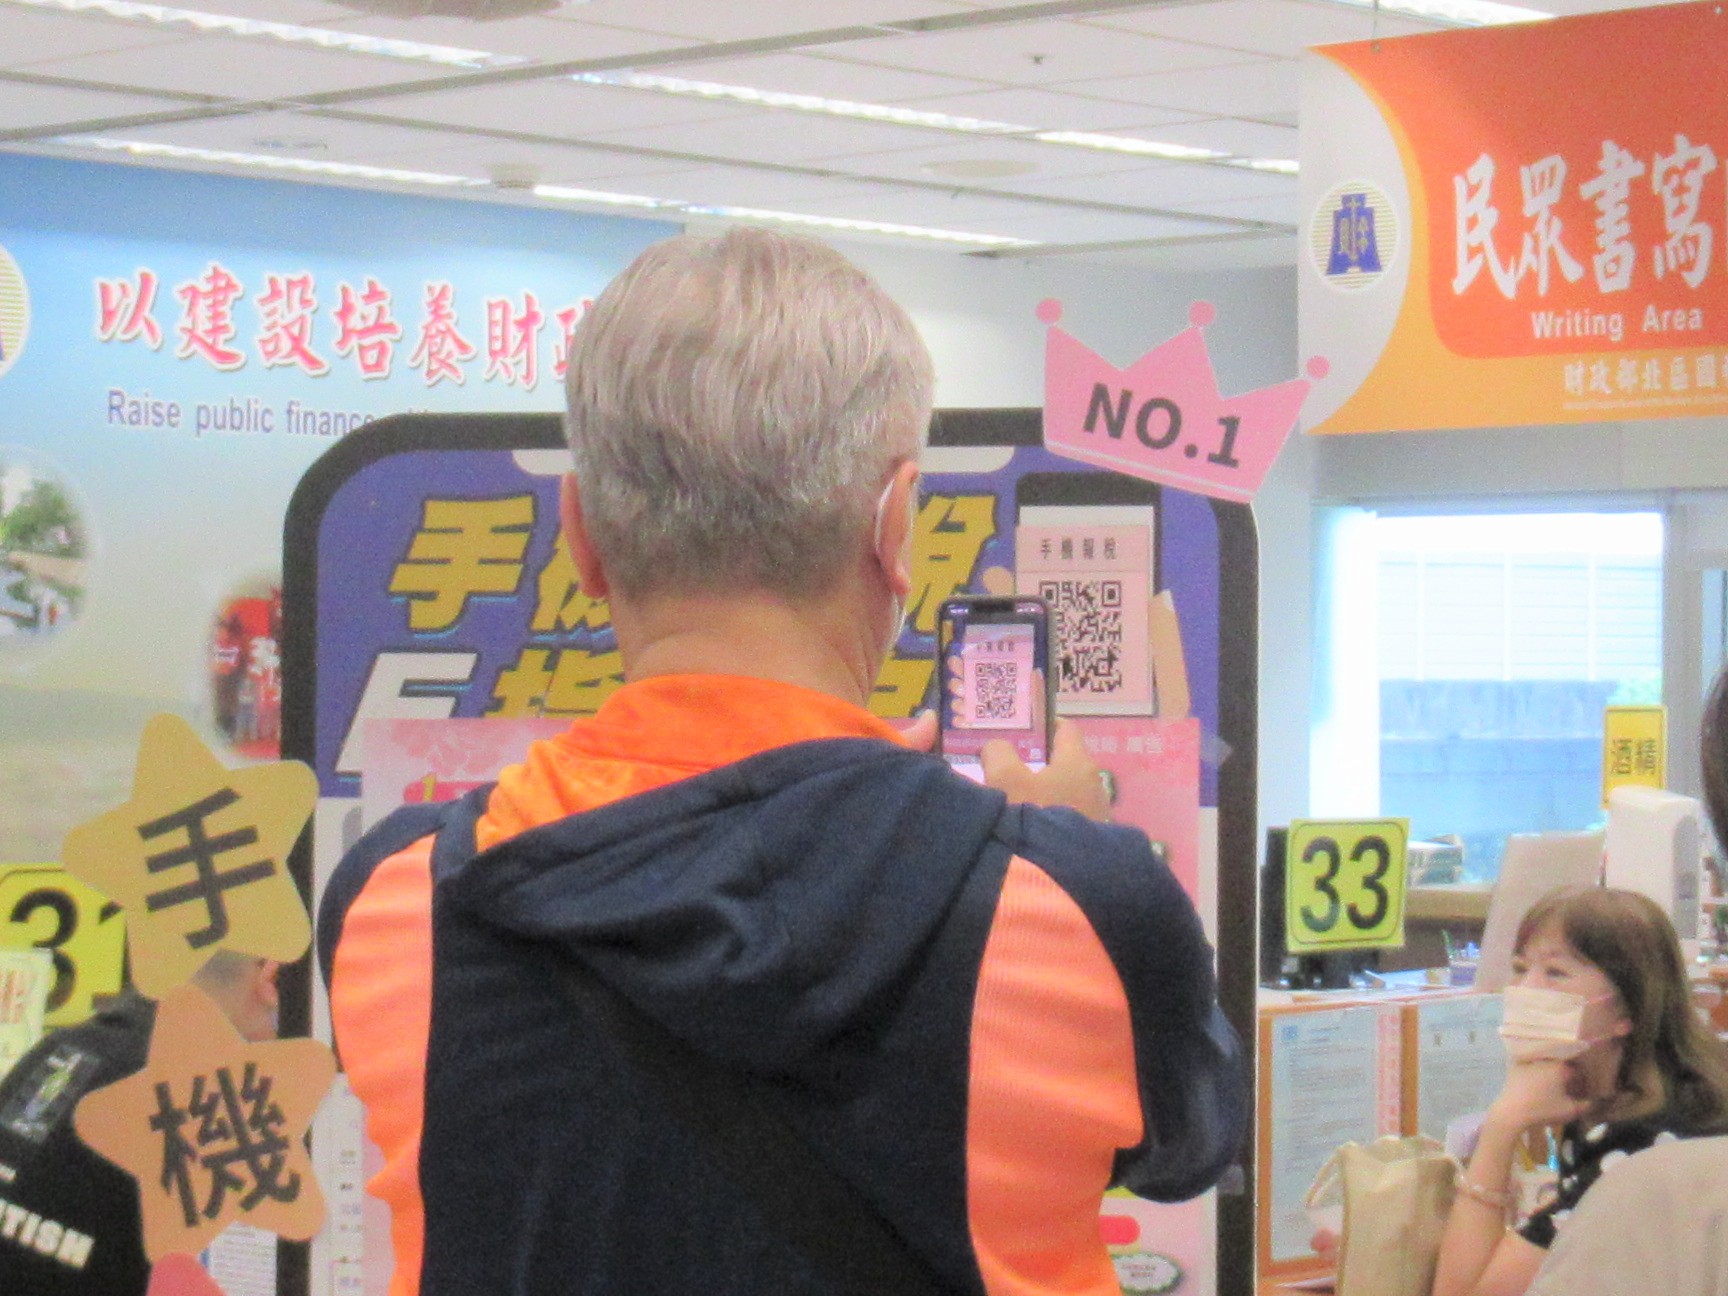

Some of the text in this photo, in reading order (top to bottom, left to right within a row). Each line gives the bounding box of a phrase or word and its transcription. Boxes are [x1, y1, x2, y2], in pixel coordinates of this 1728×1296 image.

[1531, 306, 1704, 341] Writing Area
[108, 388, 181, 428] Raise
[195, 398, 274, 437] public
[1081, 381, 1244, 469] NO.1
[1299, 835, 1392, 933] 33
